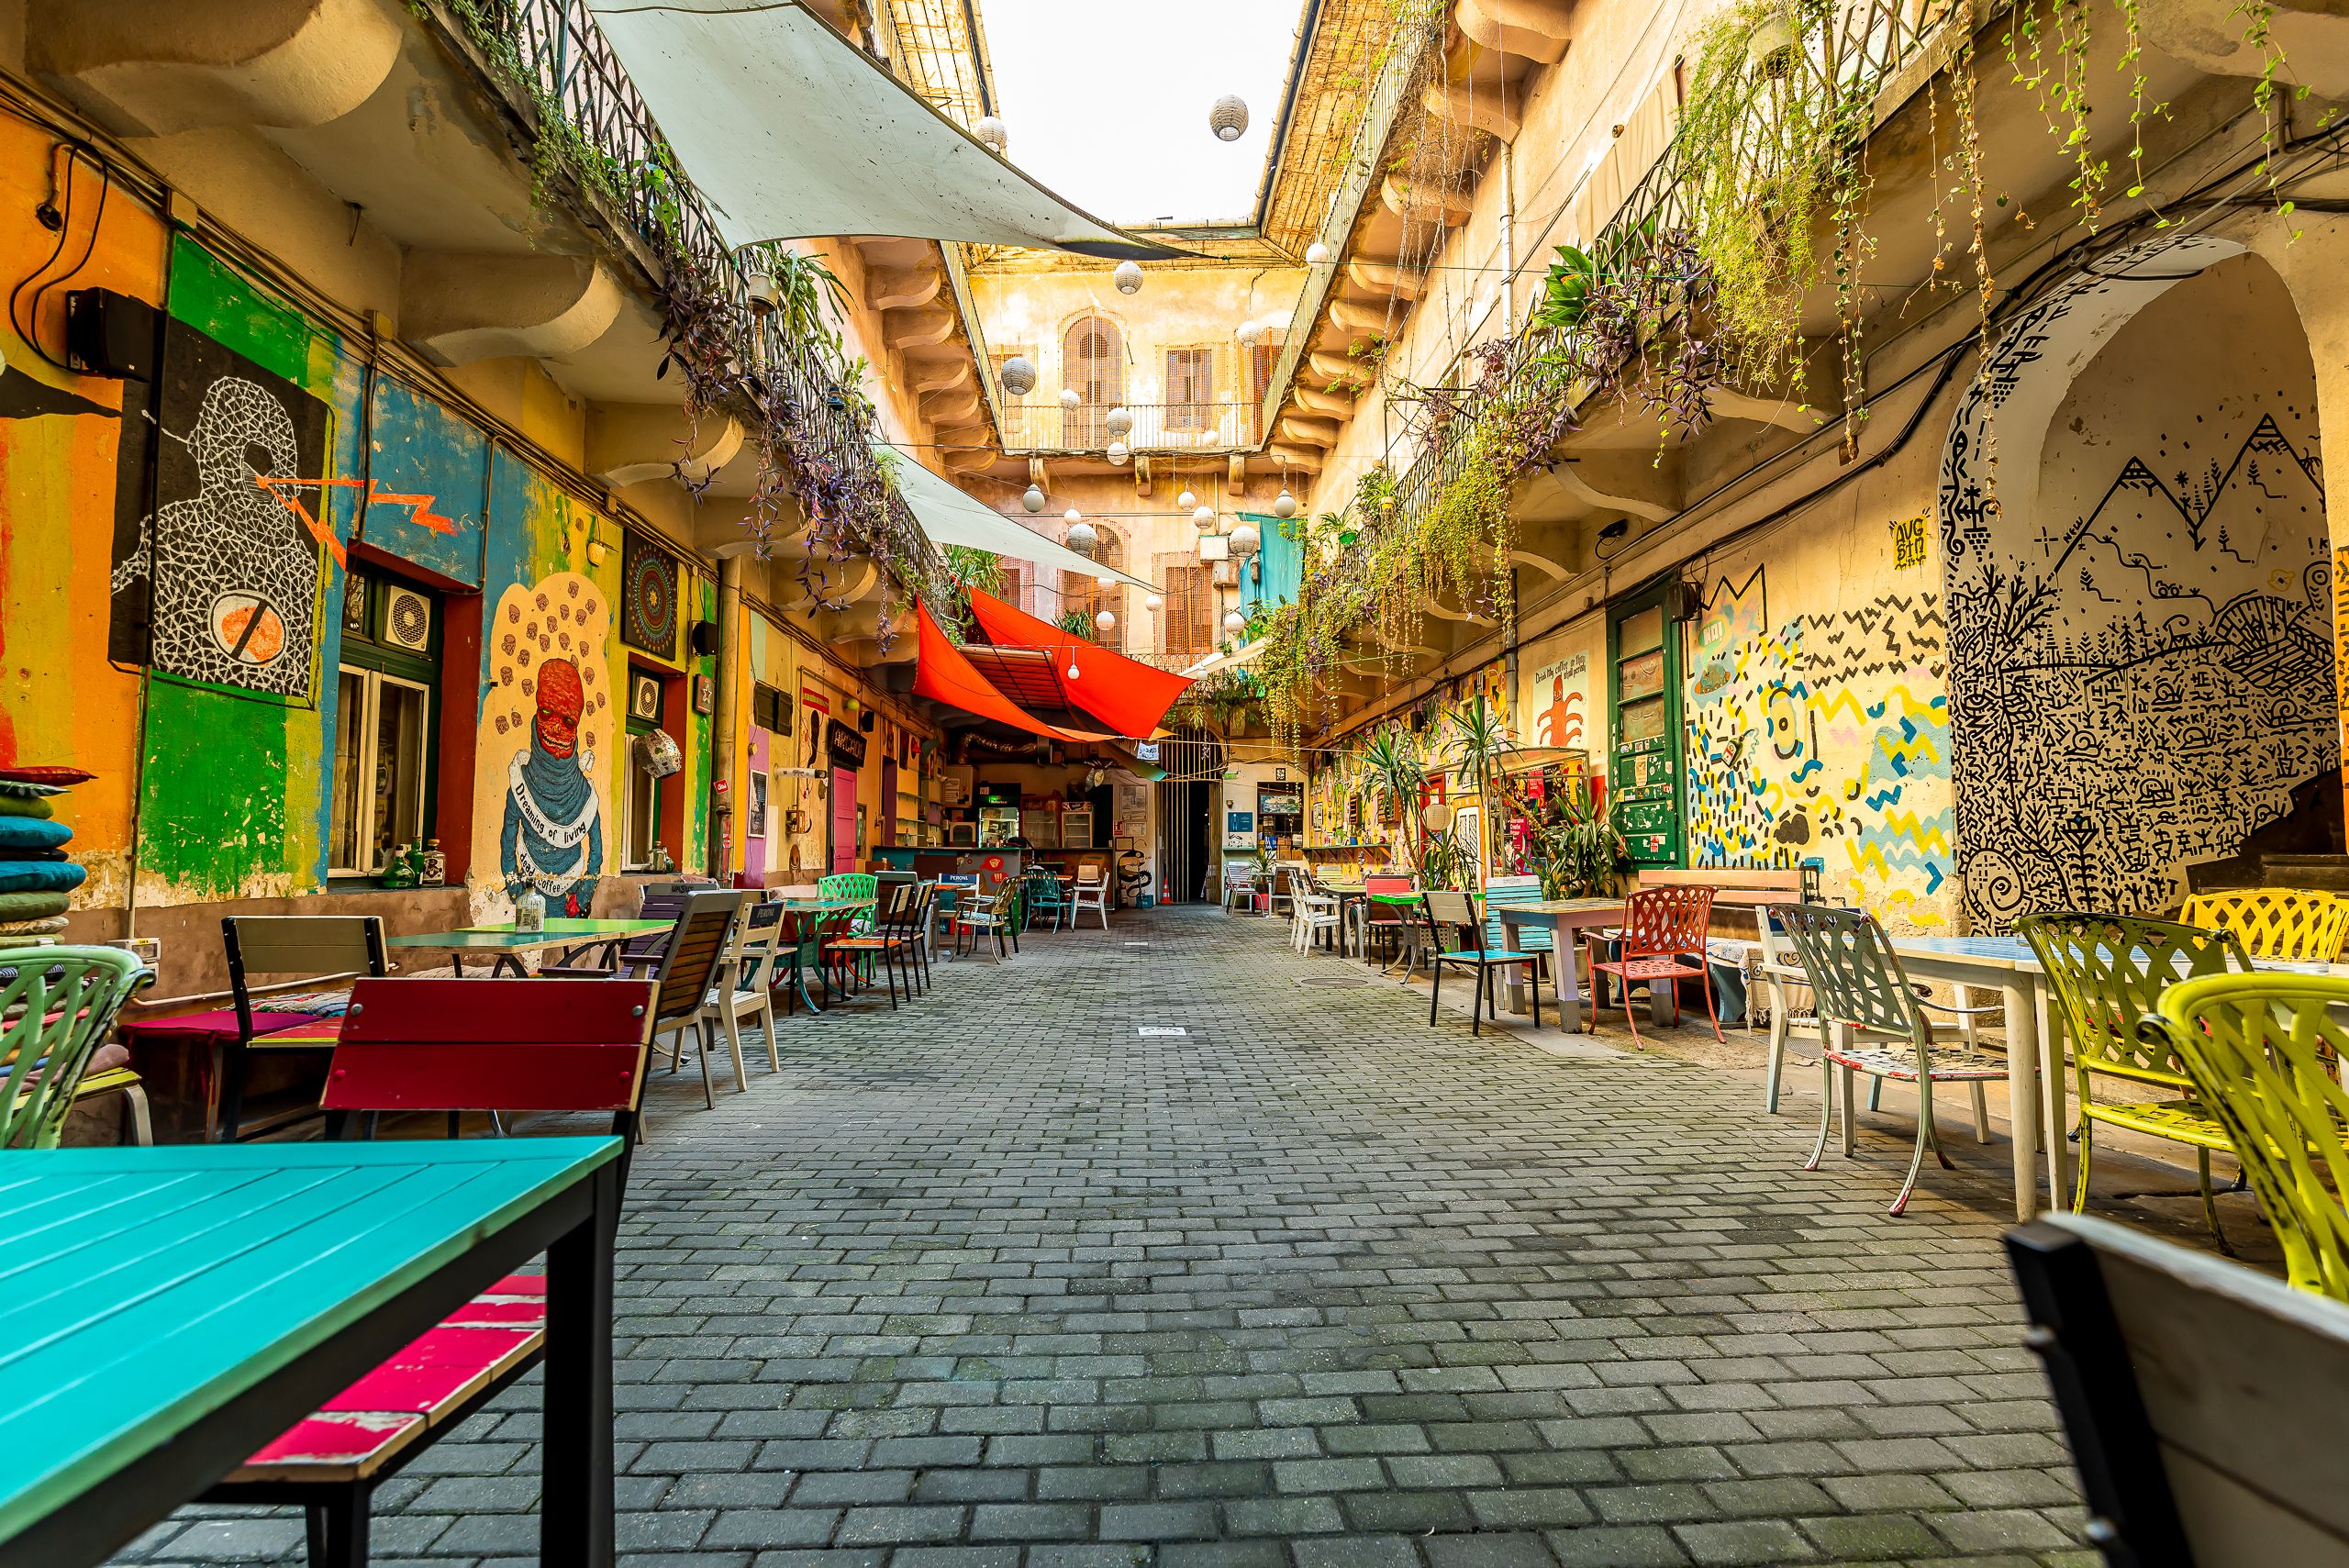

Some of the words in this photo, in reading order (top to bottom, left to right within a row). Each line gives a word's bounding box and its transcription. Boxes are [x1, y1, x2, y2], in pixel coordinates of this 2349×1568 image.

[2063, 516, 2083, 544] NEW
[2287, 600, 2303, 613] KF
[516, 783, 545, 834] Dreaming
[548, 828, 558, 841] of
[563, 821, 586, 844] living
[519, 852, 536, 877] dead
